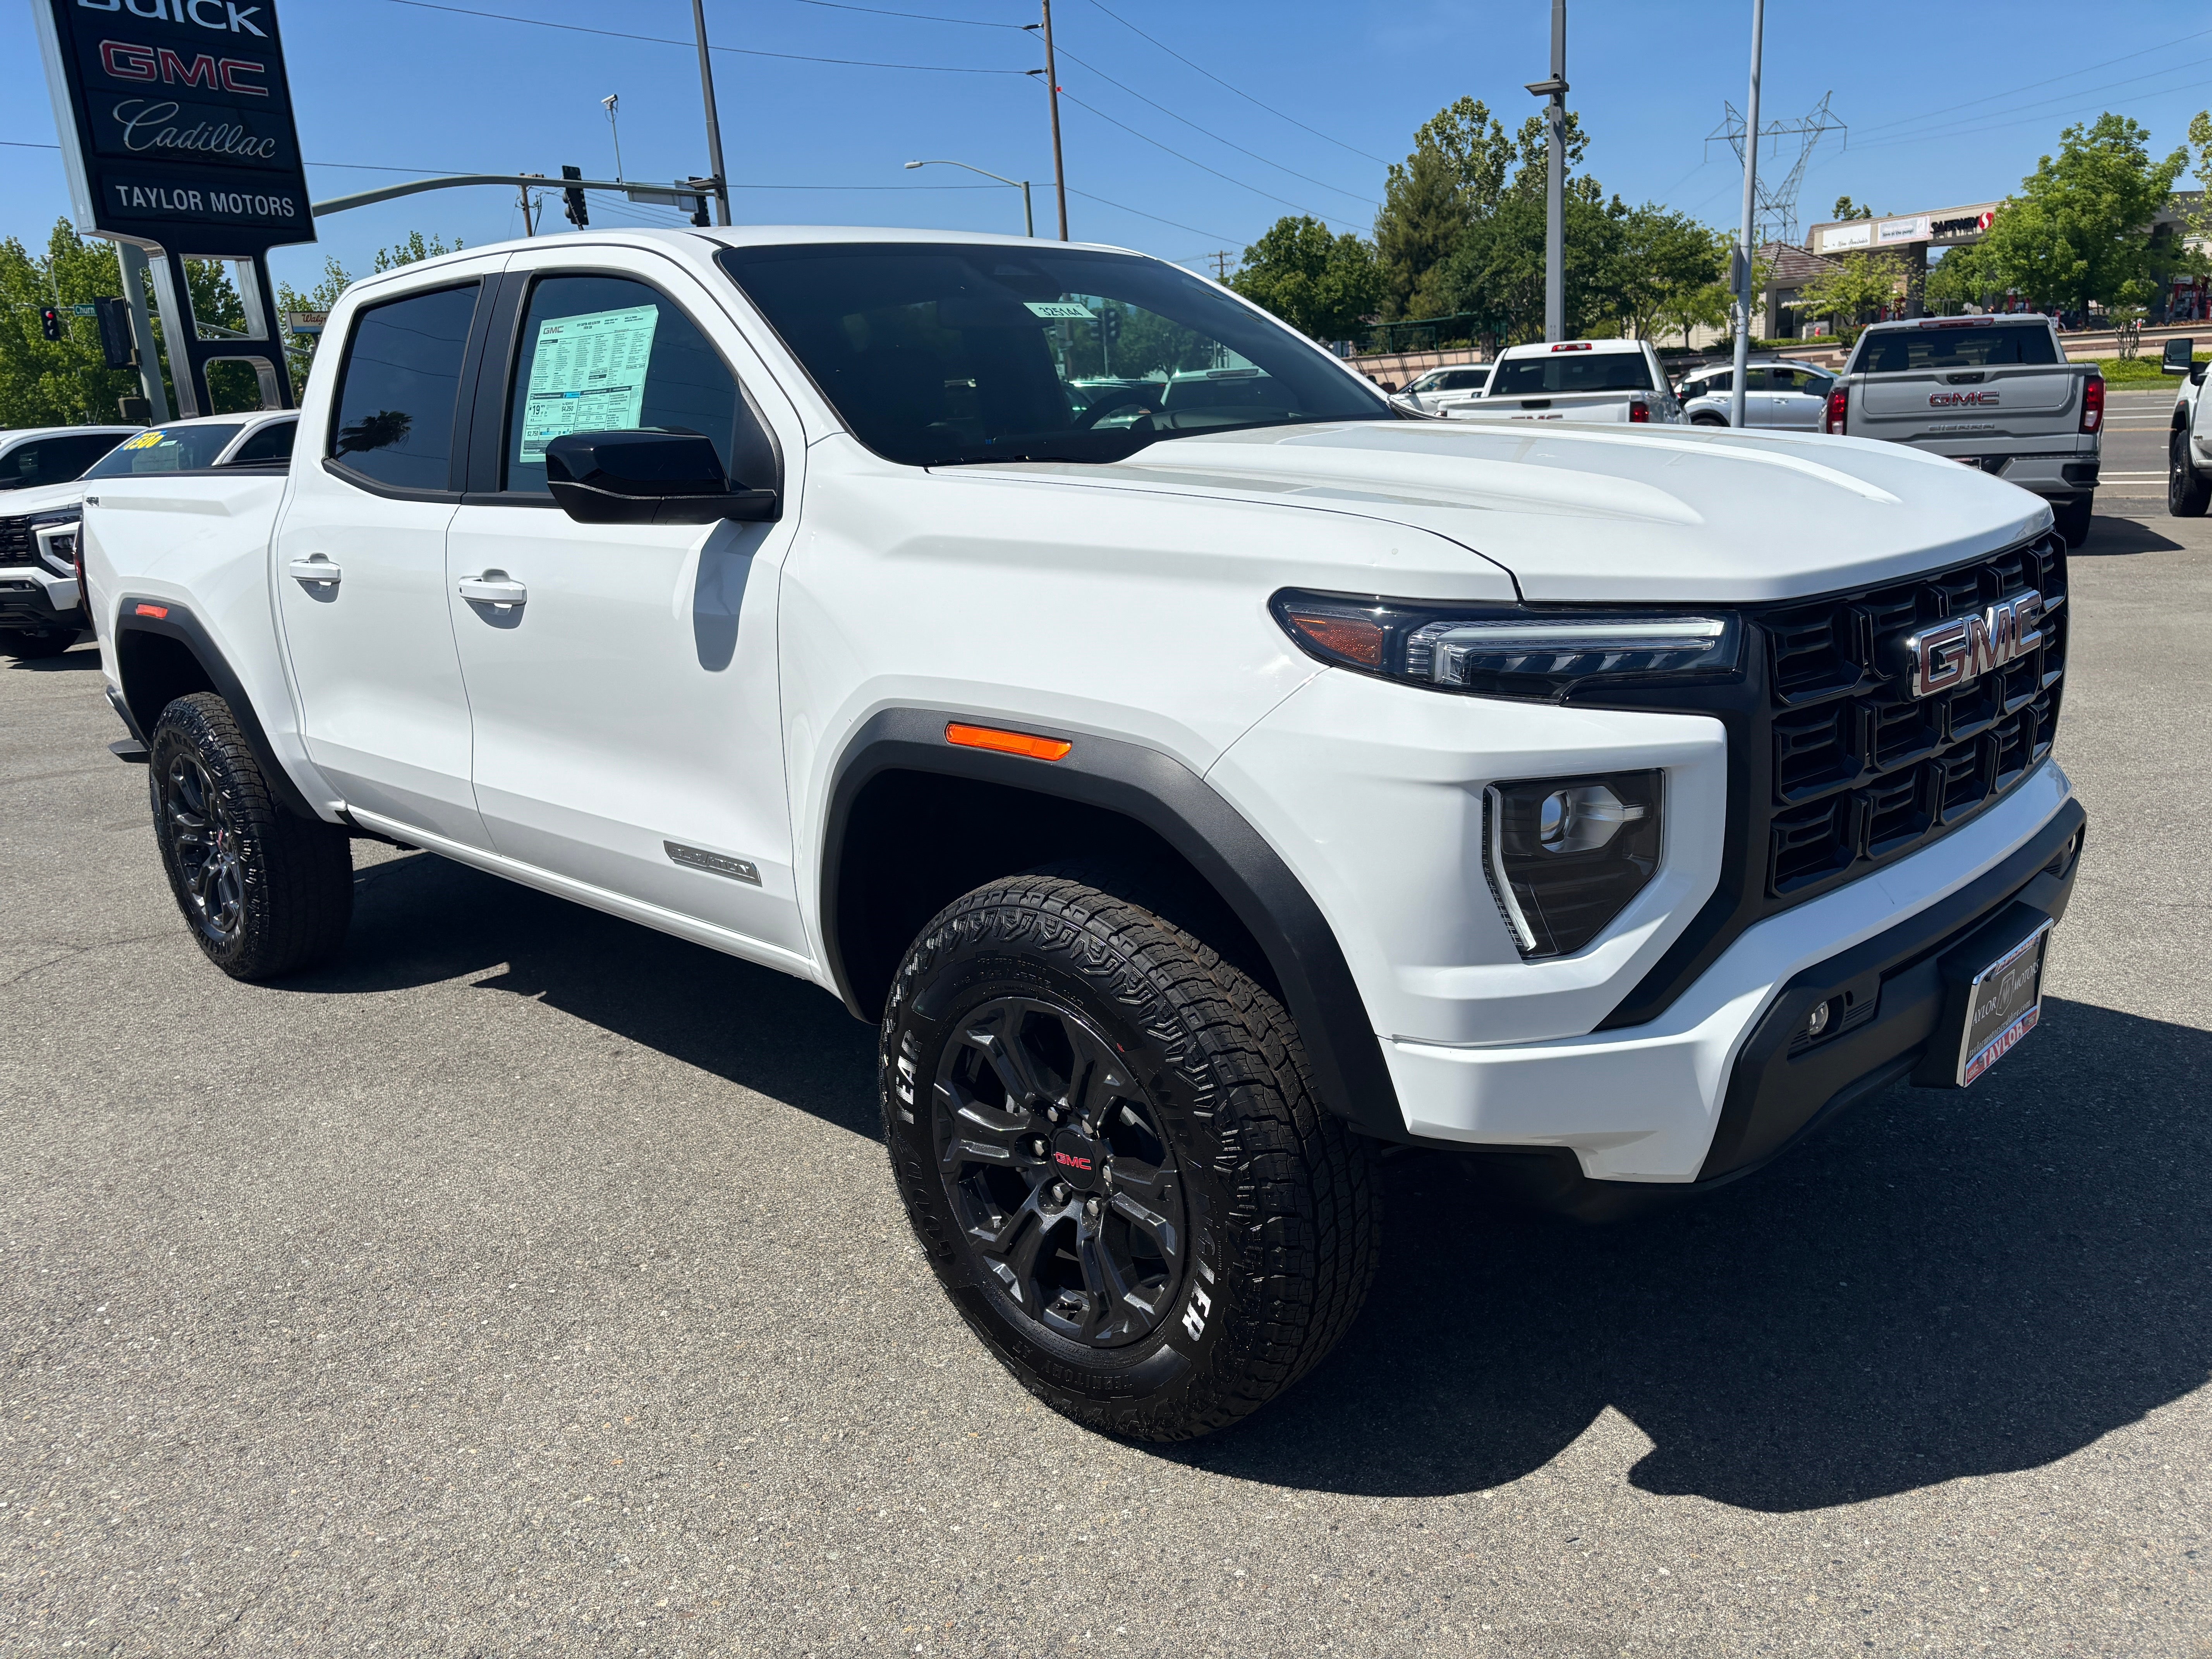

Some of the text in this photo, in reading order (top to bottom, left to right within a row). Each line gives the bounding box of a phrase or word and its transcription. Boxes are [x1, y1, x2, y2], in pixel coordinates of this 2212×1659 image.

[99, 40, 269, 97] GMC
[113, 99, 275, 158] Cadillac
[115, 185, 295, 217] TAYLOR MOTORS
[76, 306, 95, 314] Churn
[1039, 307, 1083, 316] 325144
[543, 326, 564, 335] GMC
[533, 405, 540, 415] 19
[1929, 391, 1999, 407] GMC
[1908, 590, 2042, 699] GMC
[1972, 997, 1996, 1026] AYLOR
[2013, 959, 2039, 993] MOTORS
[1982, 1021, 2023, 1068] TAYLOR
[1055, 1151, 1091, 1170] GMC
